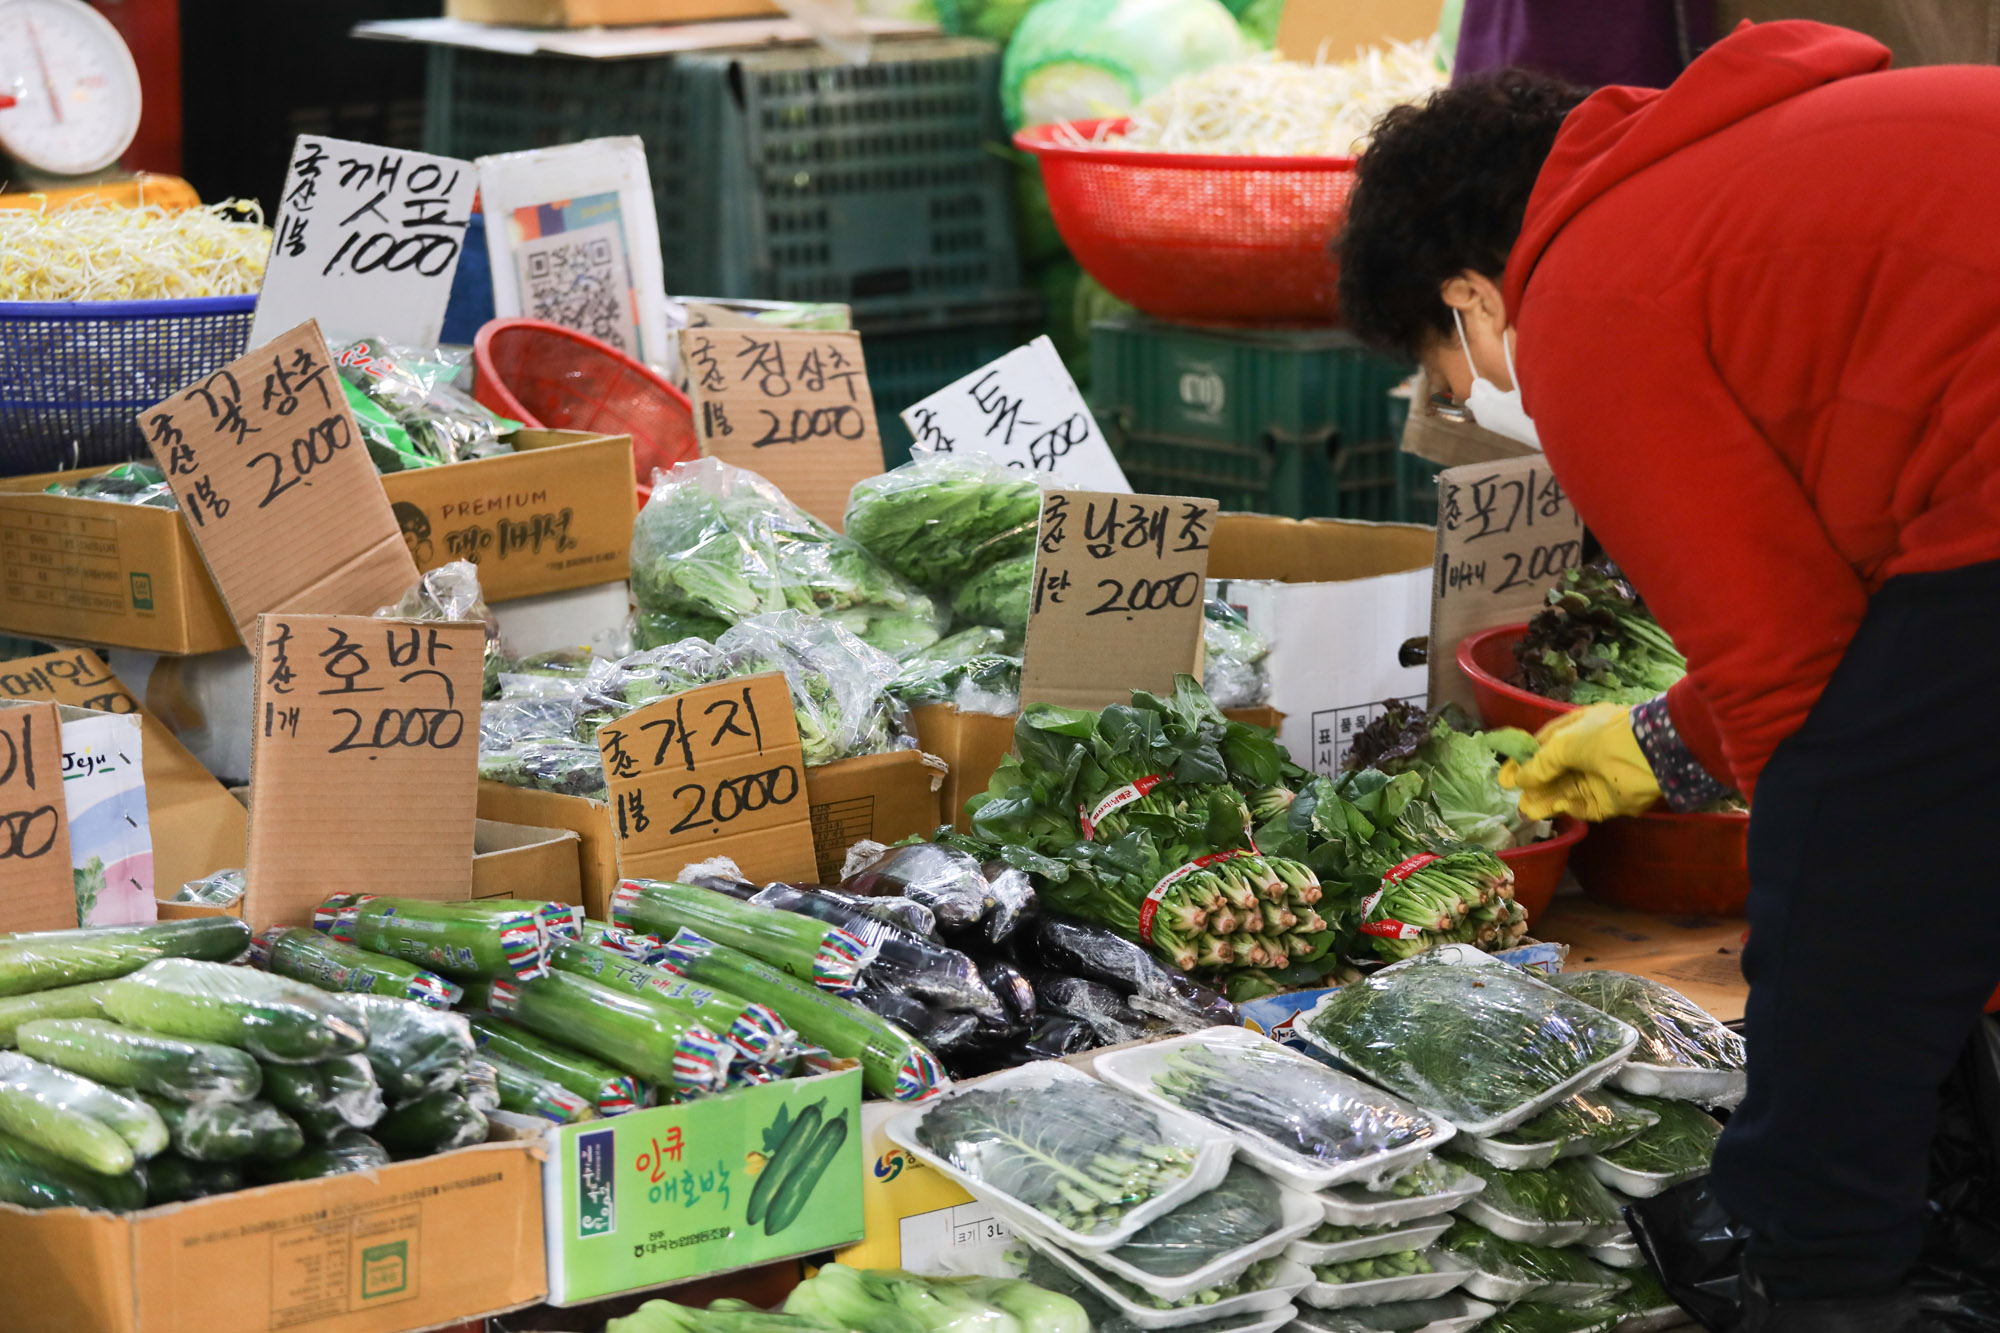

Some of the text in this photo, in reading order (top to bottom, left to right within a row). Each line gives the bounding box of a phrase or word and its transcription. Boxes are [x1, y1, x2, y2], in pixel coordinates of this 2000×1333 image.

[338, 155, 471, 228] 깻잎
[691, 336, 730, 393] 국산
[150, 414, 199, 475] 국산
[442, 490, 548, 519] PREMIUM
[1083, 496, 1209, 561] 남해초
[1463, 468, 1579, 544] 포기상
[0, 654, 116, 696] 메인
[318, 627, 455, 709] 호박
[62, 745, 107, 777] Jeju
[602, 687, 764, 779] 국산 가지
[634, 1126, 686, 1183] 인큐
[647, 1160, 731, 1211] 애호박
[957, 1228, 976, 1243] 크기
